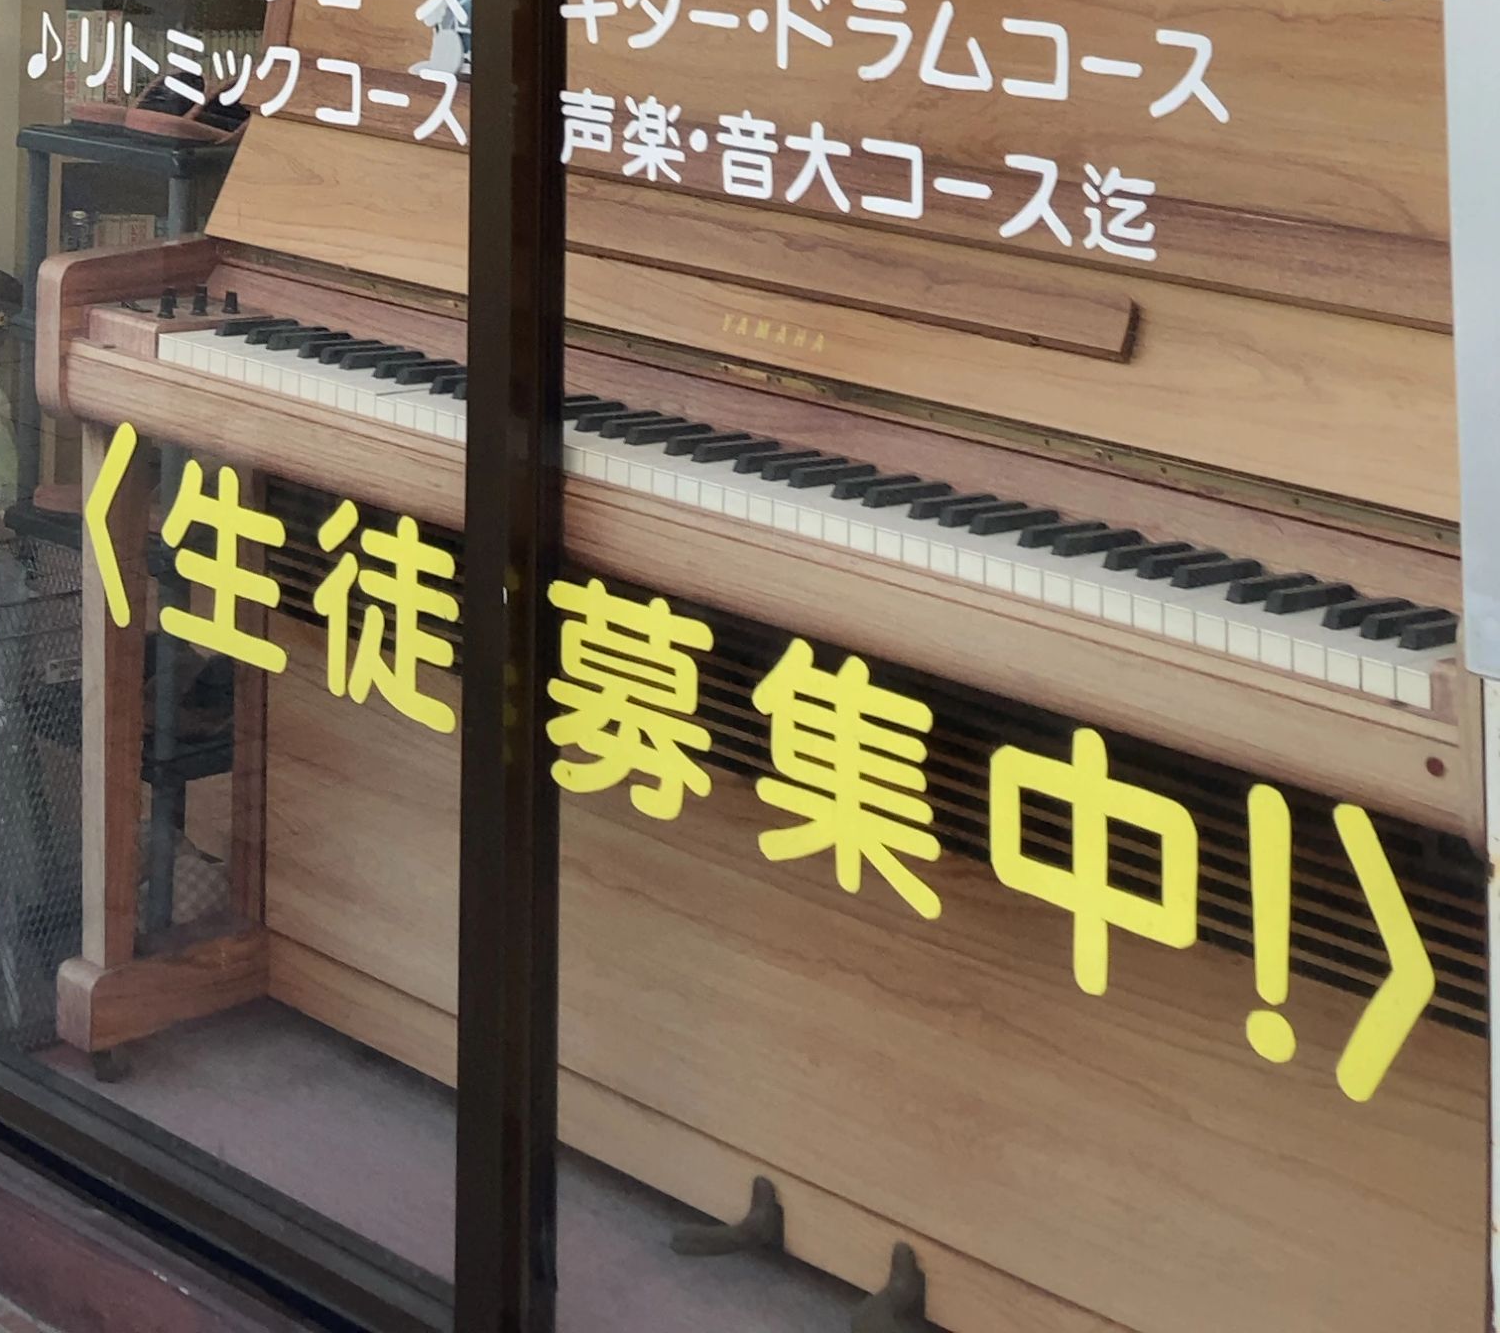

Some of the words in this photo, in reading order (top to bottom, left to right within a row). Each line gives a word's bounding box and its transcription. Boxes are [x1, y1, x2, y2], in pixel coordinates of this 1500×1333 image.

[80, 16, 468, 146] リトミックコース
[560, 87, 1158, 261] 声楽・音大コース迄
